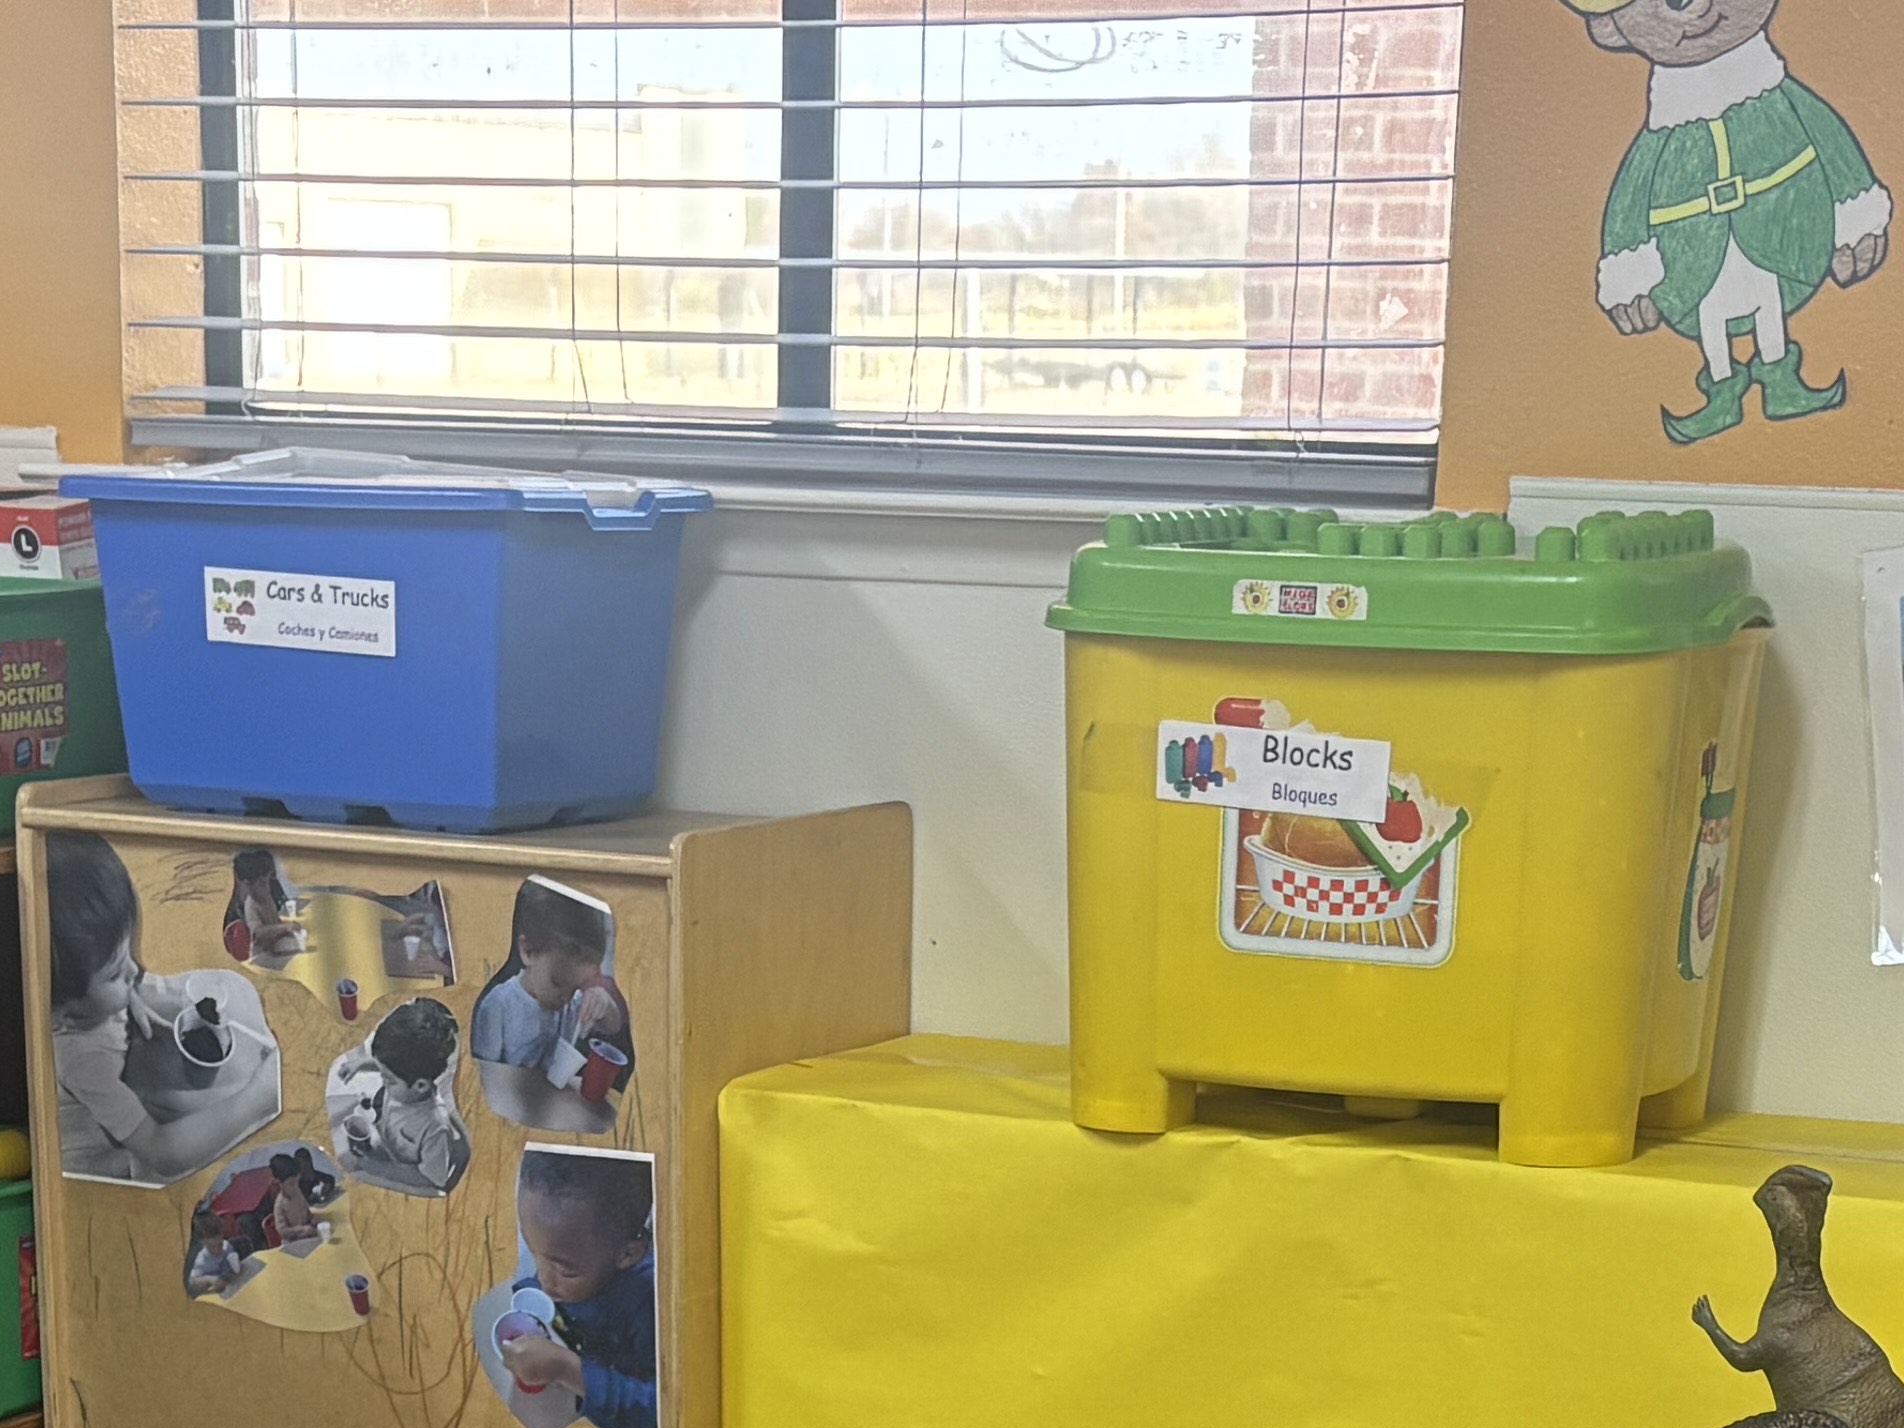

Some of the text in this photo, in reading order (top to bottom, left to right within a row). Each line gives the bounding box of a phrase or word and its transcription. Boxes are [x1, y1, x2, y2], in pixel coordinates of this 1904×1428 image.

[266, 580, 390, 609] Cars & Trucks
[277, 621, 380, 643] Coches y Camiones
[1262, 734, 1353, 771] Blocks
[1271, 782, 1338, 808] Bloques
